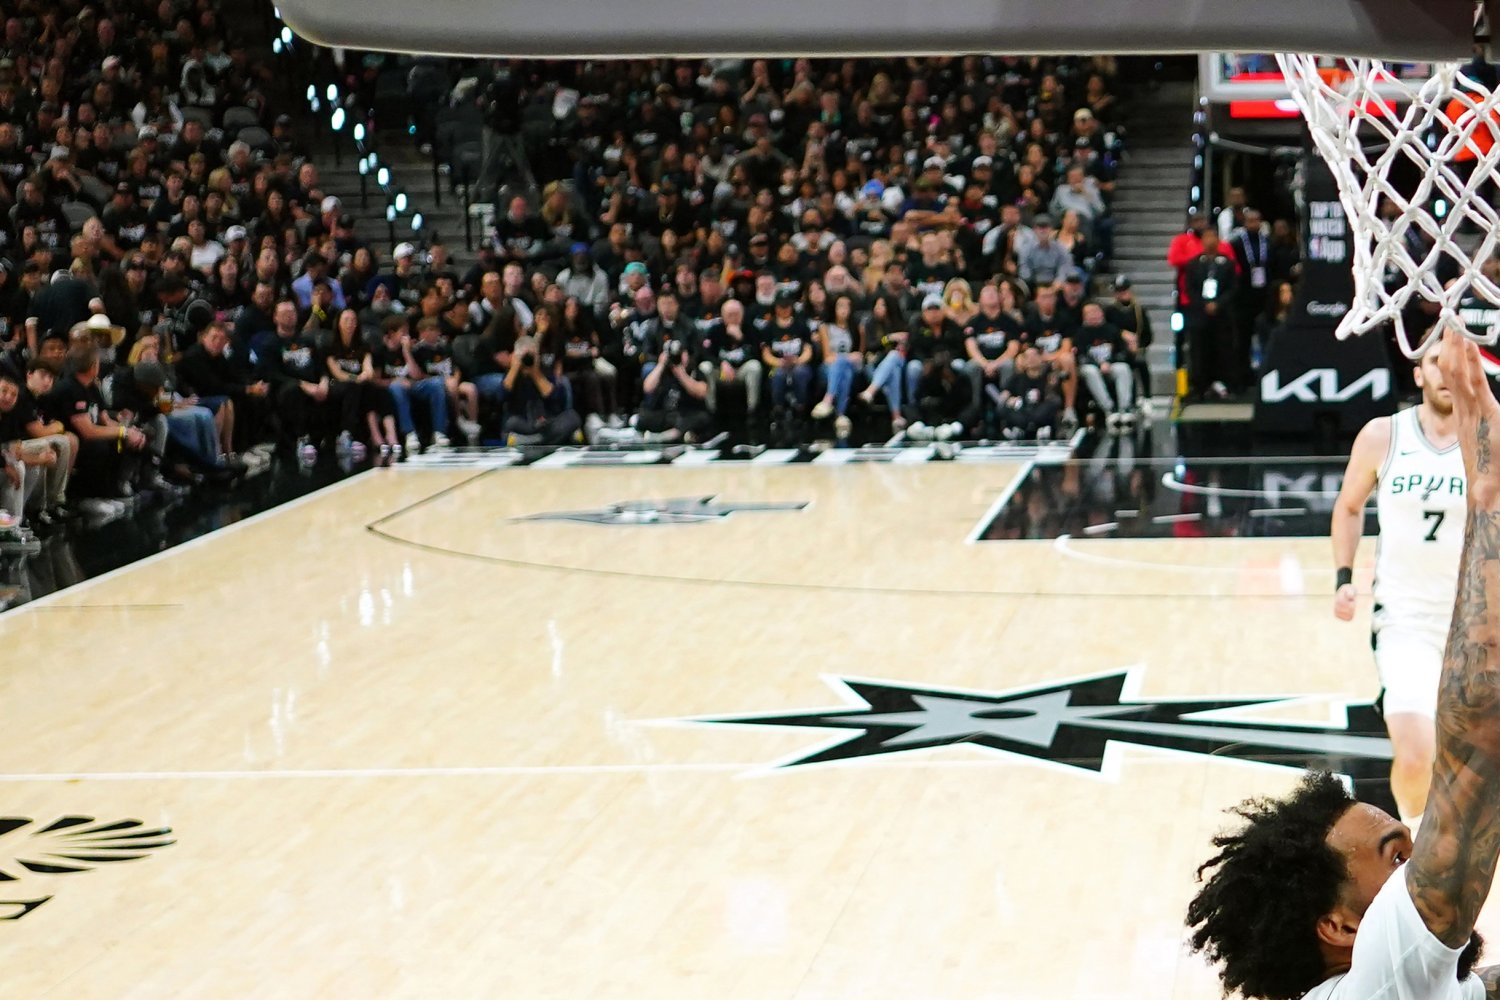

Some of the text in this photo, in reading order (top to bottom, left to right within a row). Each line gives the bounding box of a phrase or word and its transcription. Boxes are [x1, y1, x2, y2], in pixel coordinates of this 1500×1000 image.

[1261, 368, 1391, 402] KIA
[1391, 474, 1464, 501] SPUR
[1423, 510, 1445, 541] 7
